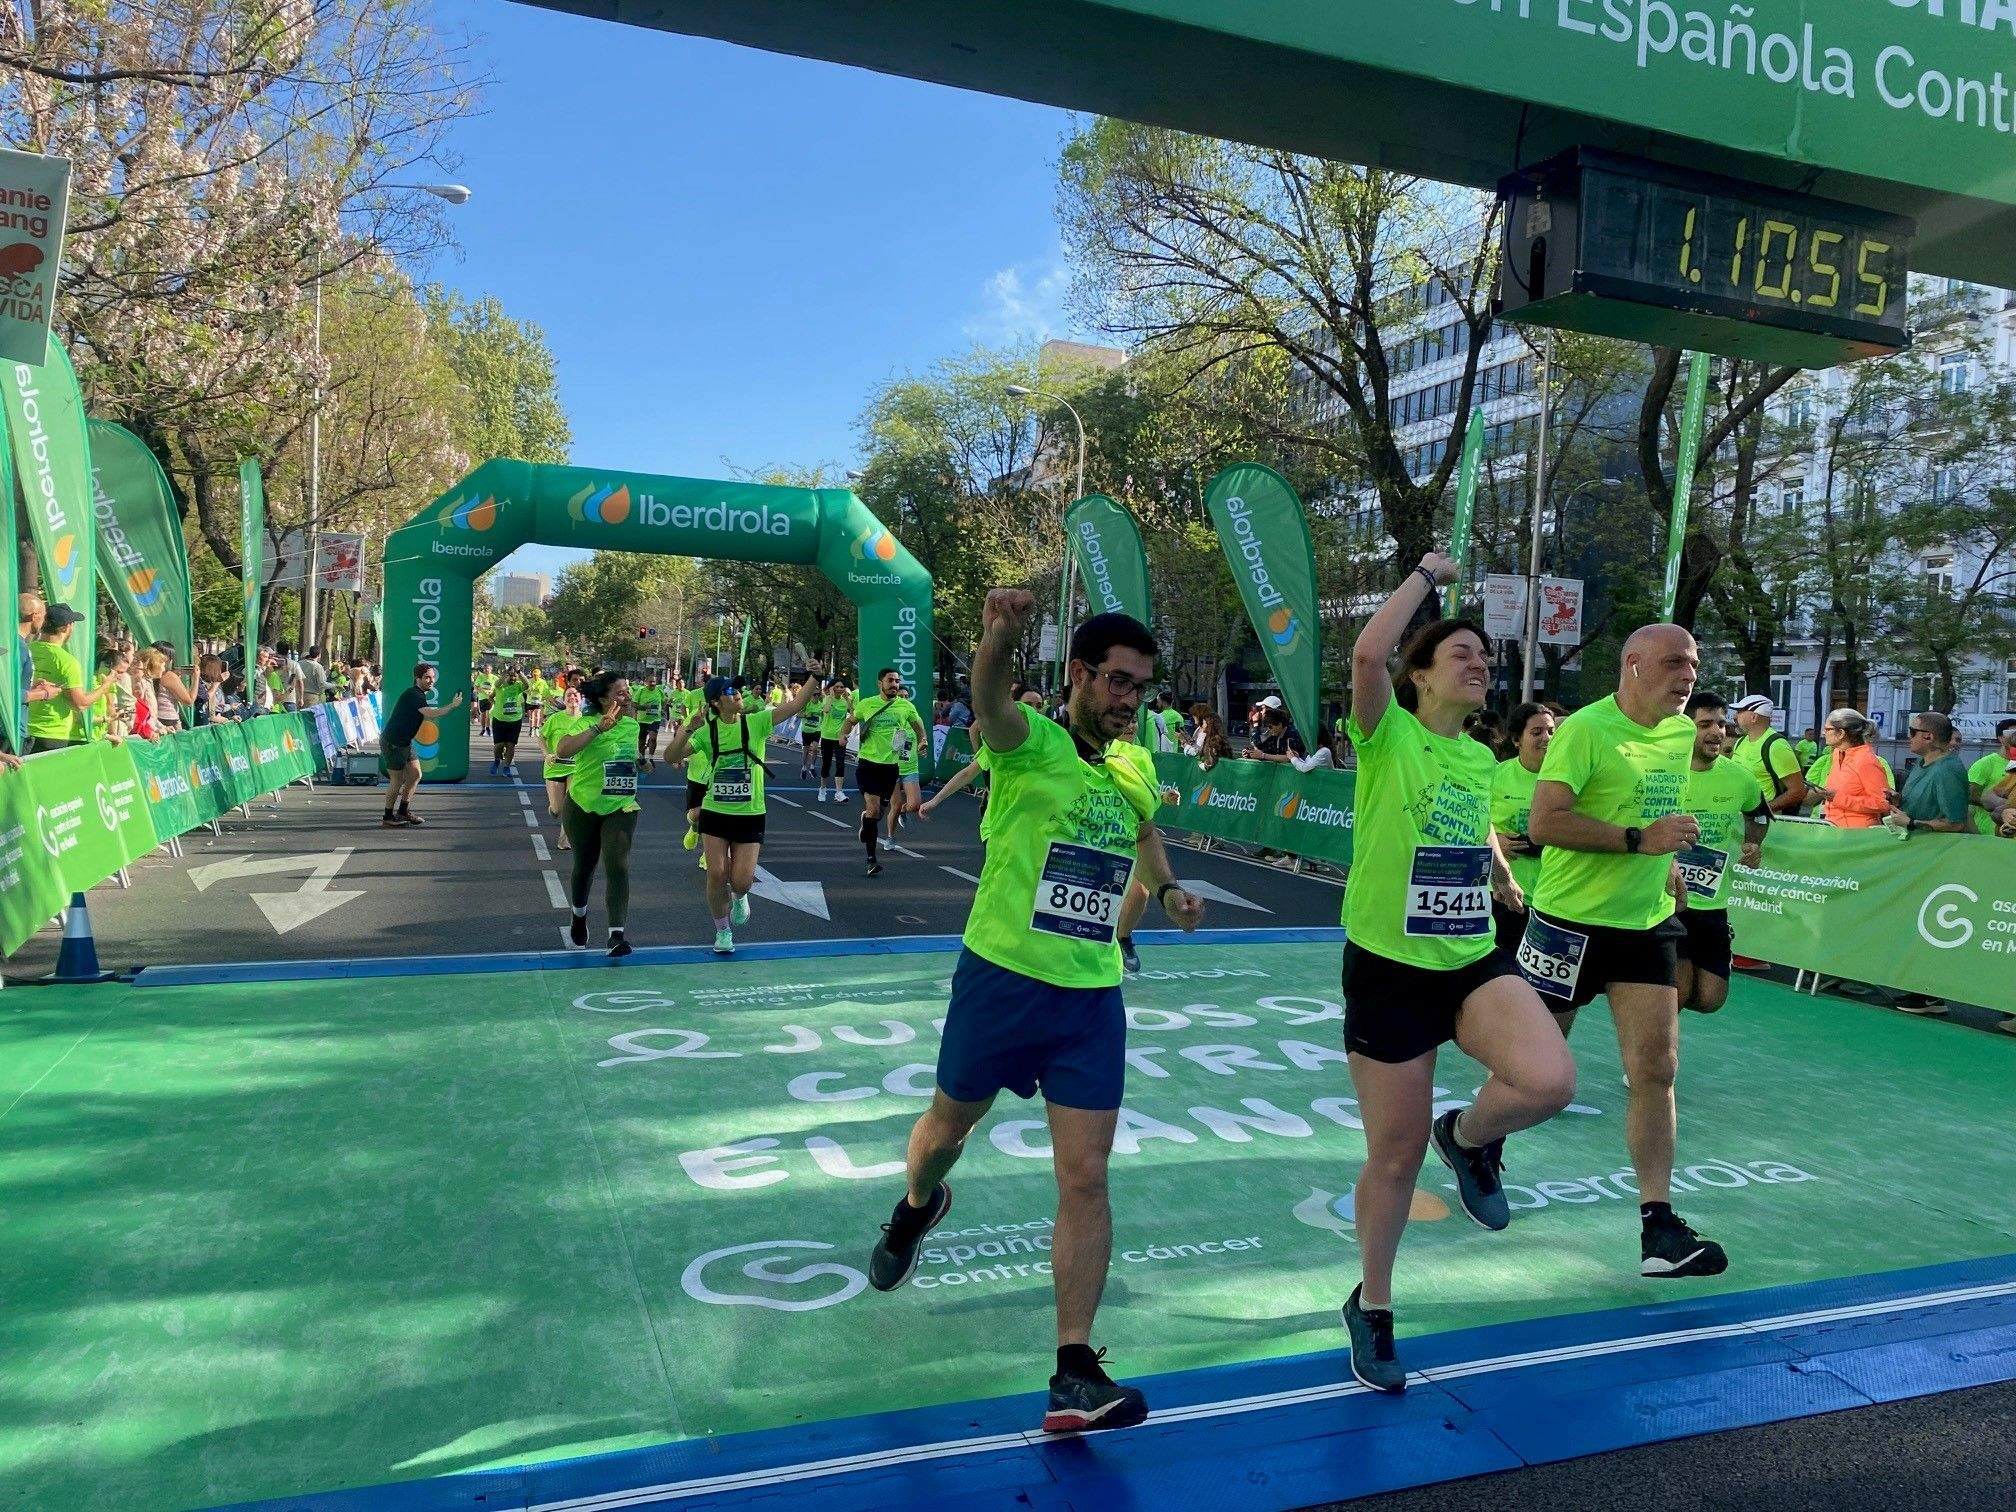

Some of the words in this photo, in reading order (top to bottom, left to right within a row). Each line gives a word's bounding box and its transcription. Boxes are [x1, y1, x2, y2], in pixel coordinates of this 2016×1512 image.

[1557, 0, 1855, 98] Española
[1875, 45, 2016, 135] Cont
[639, 494, 790, 536] Iberdrola
[431, 540, 494, 556] Iberdrola
[847, 571, 901, 585] Iberdrola
[893, 607, 916, 700] erdrola
[605, 777, 634, 788] 18135
[714, 783, 749, 795] 13348
[1645, 774, 1677, 783] MADRID
[1645, 785, 1680, 795] MARCHA
[1208, 786, 1258, 812] Iberdrola
[1436, 796, 1480, 825] MARCHA
[1644, 797, 1677, 806] CONTRA
[1296, 798, 1355, 829] Iberdrola
[1431, 810, 1476, 838] CONTRA
[1732, 862, 1799, 884] asociación
[1800, 874, 1860, 892] española
[1050, 884, 1111, 922] 8063
[1417, 890, 1486, 915] 15411
[1732, 879, 1766, 894] contra
[1767, 885, 1780, 896] el
[1780, 888, 1828, 904] cáncer
[1727, 896, 1742, 907] en
[1743, 896, 1783, 915] Madrid
[1981, 939, 2003, 952] en
[763, 1003, 1258, 1054] JUOS
[787, 1040, 1350, 1102] COTRA
[678, 1136, 909, 1190] EL
[1121, 1234, 1263, 1264] cáncer
